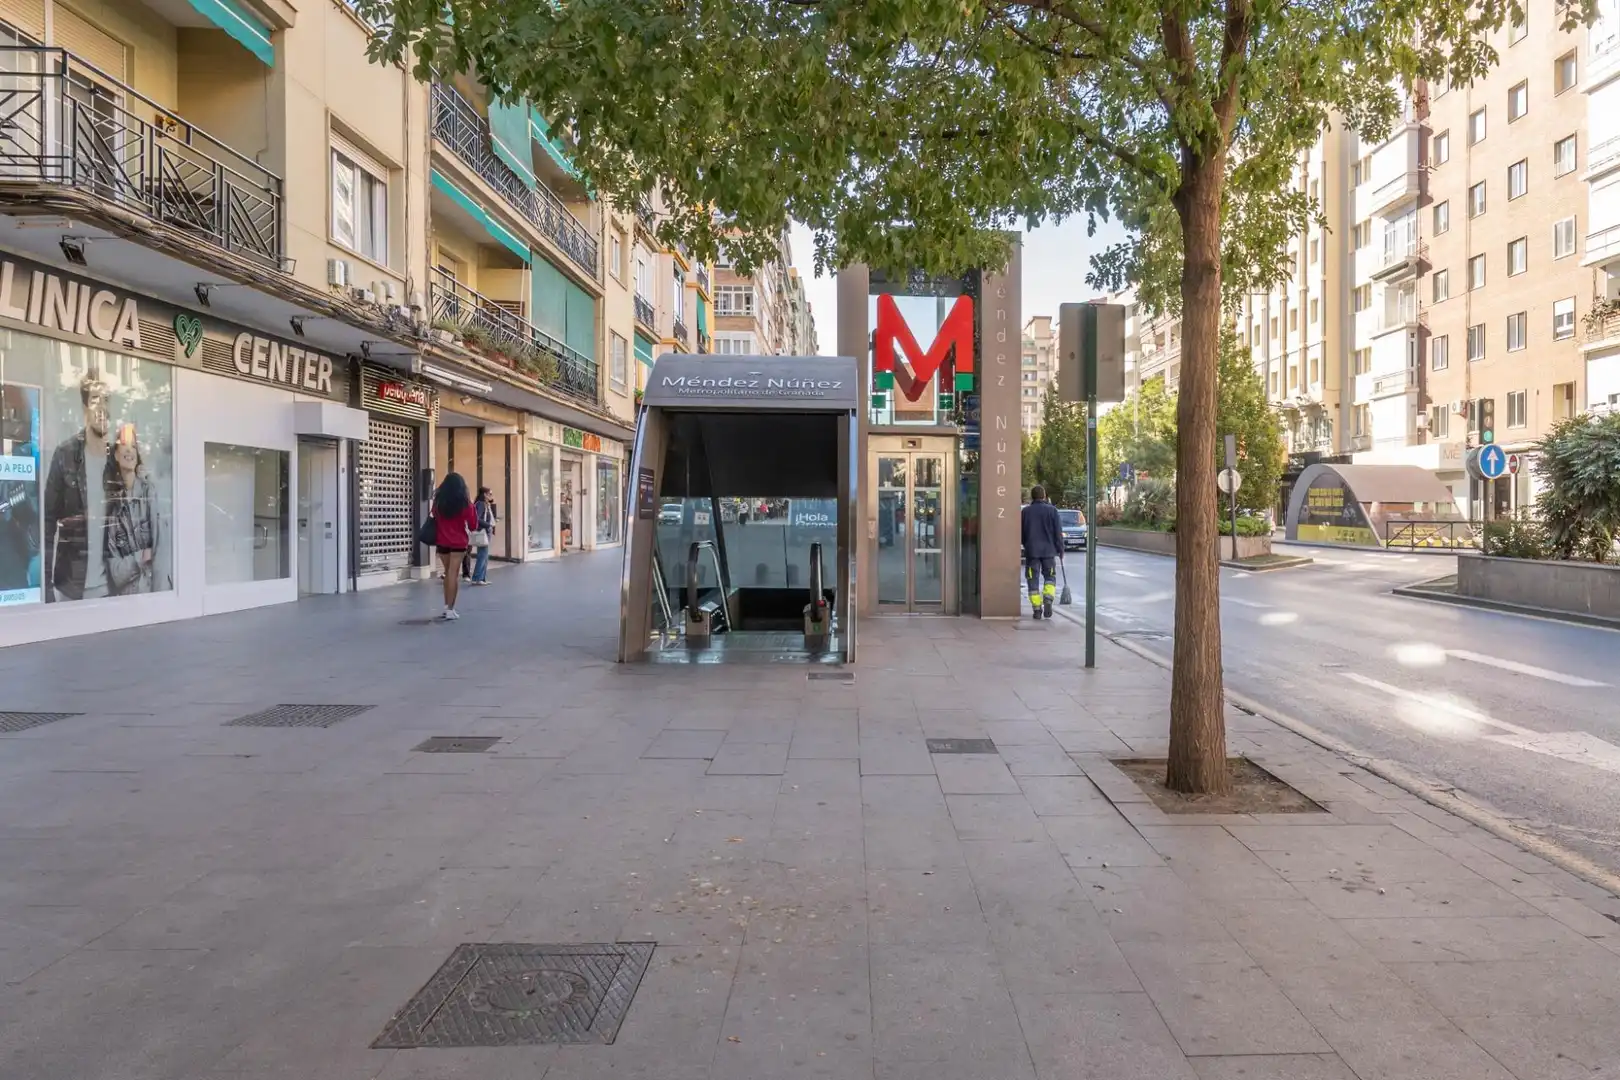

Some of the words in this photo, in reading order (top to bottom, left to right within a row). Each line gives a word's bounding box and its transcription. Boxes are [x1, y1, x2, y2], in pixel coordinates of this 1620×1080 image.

[876, 293, 974, 391] M
[233, 332, 332, 392] CENTER
[662, 375, 759, 388] Méndez
[767, 377, 843, 389] Núñez
[678, 387, 760, 396] Metropolitano
[12, 463, 33, 474] PELO
[995, 416, 1007, 519] Núñez
